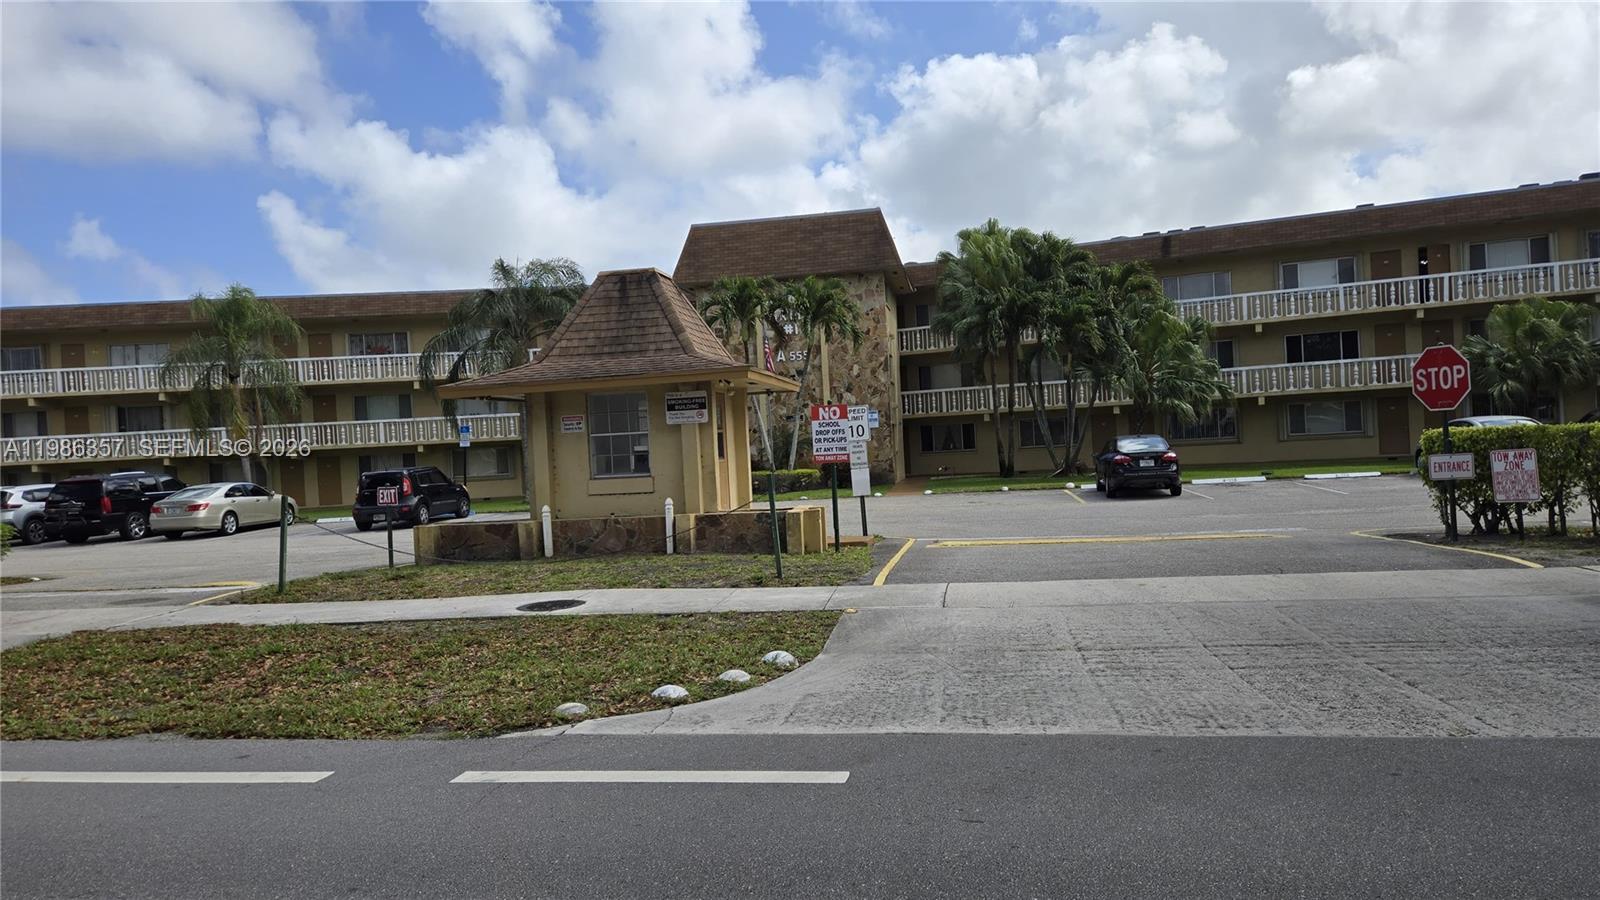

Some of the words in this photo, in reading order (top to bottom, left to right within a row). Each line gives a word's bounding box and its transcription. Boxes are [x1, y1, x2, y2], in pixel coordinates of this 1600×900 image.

[1416, 365, 1465, 392] STOP
[819, 406, 840, 420] NO
[848, 424, 865, 438] 10
[1493, 452, 1509, 462] TOW
[1513, 450, 1533, 461] AWAY
[1433, 461, 1471, 473] ENTRANCE
[1504, 460, 1525, 471] ZONE
[379, 490, 396, 503] EXIT
